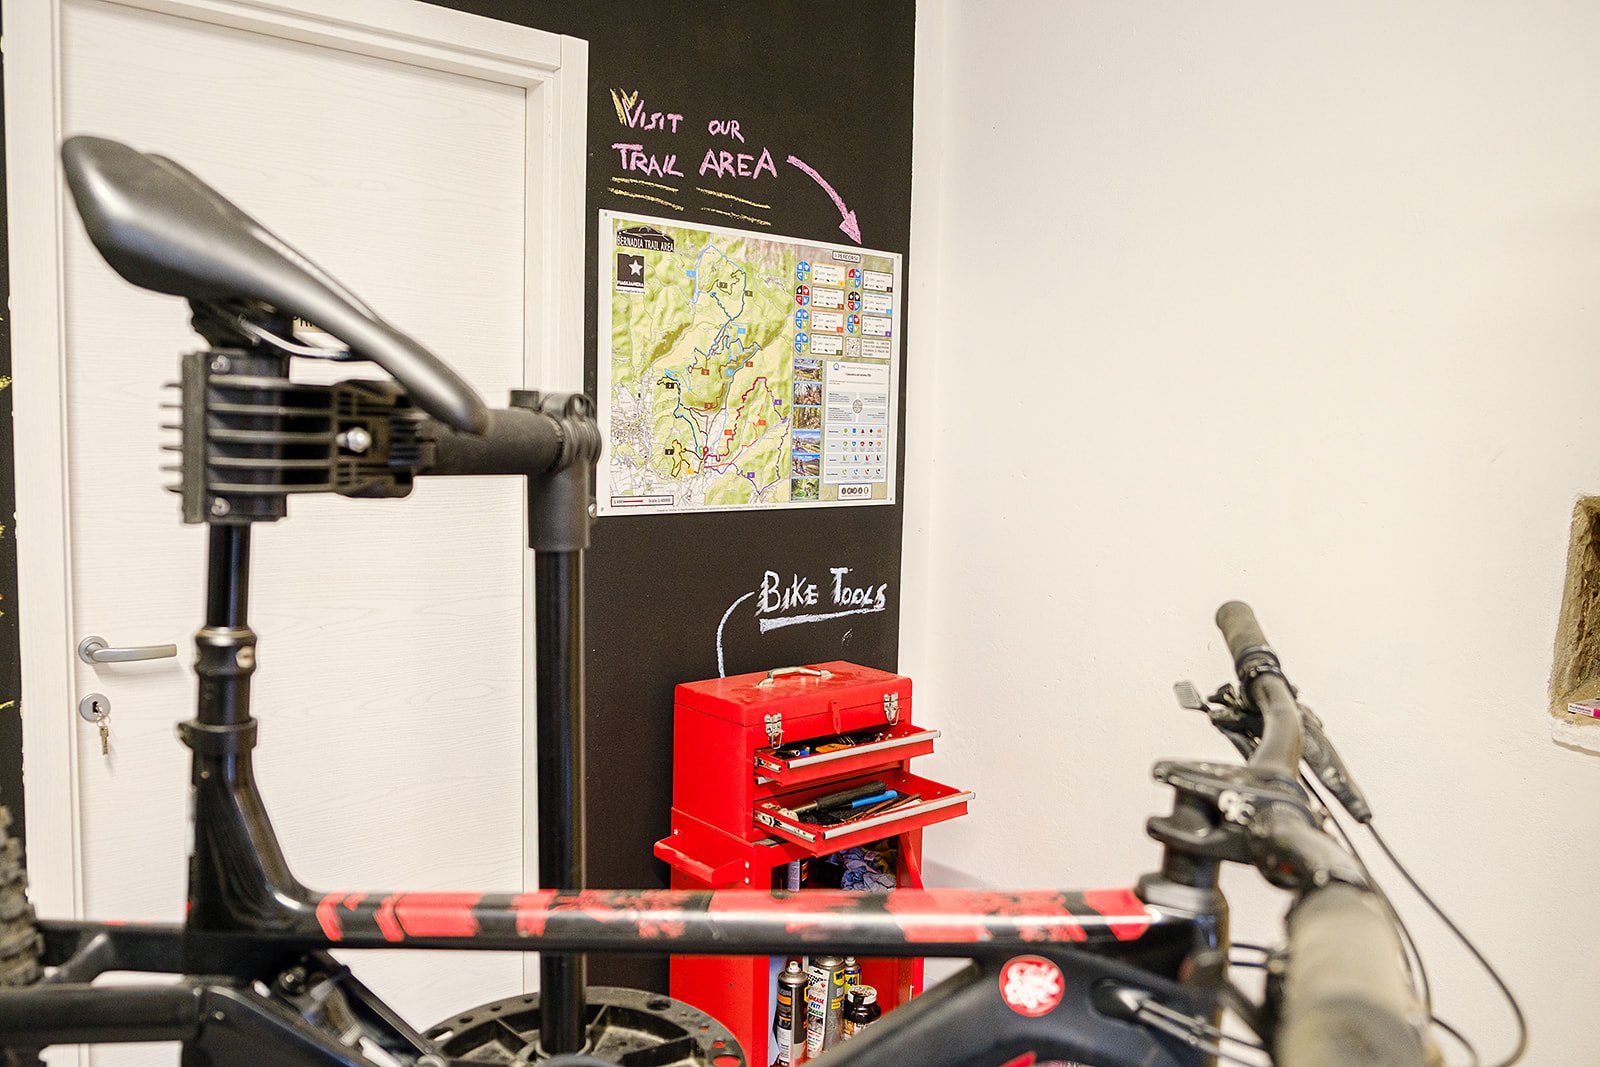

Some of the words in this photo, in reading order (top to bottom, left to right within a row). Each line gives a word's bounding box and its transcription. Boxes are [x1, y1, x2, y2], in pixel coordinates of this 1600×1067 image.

[708, 119, 745, 143] OUR
[611, 143, 685, 178] TRAIL
[699, 147, 778, 180] AREA
[644, 239, 660, 251] TRAIL
[660, 241, 674, 252] AREA
[754, 570, 819, 616] BIKE
[830, 567, 888, 609] TOOLS
